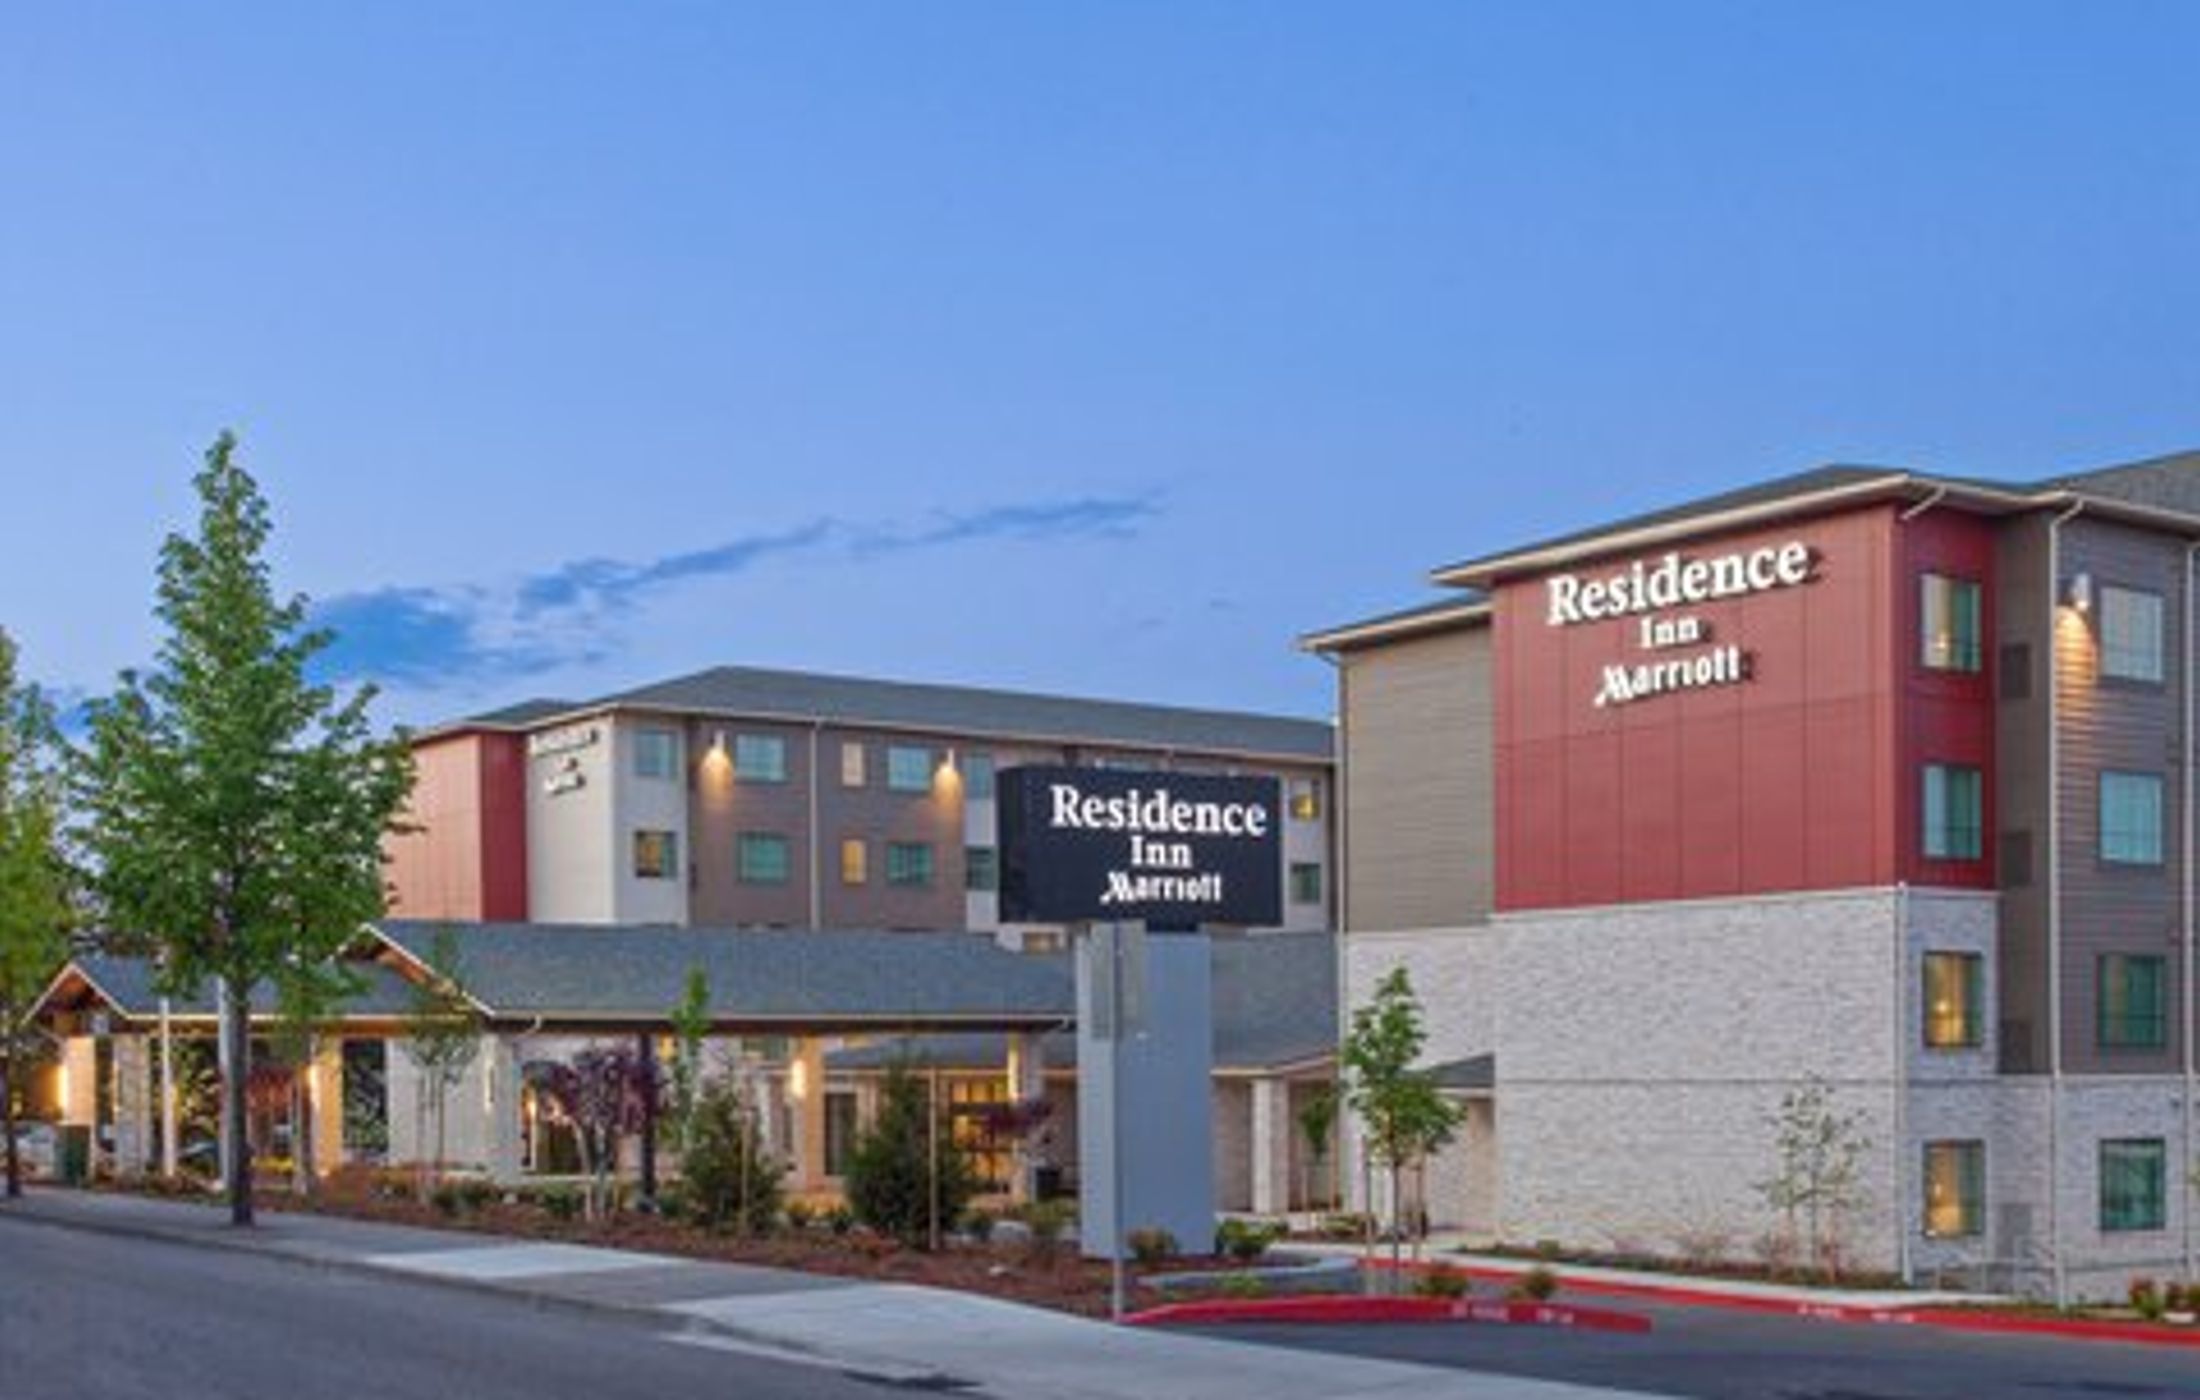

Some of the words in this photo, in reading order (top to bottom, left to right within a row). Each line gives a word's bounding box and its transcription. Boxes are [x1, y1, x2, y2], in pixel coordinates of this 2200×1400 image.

[1546, 540, 1808, 626] Residence
[1640, 614, 1698, 648] Inn
[1593, 645, 1741, 706] Marriott
[1050, 784, 1267, 836] Residence
[1130, 835, 1192, 868] Inn
[1100, 871, 1222, 904] Marriott
